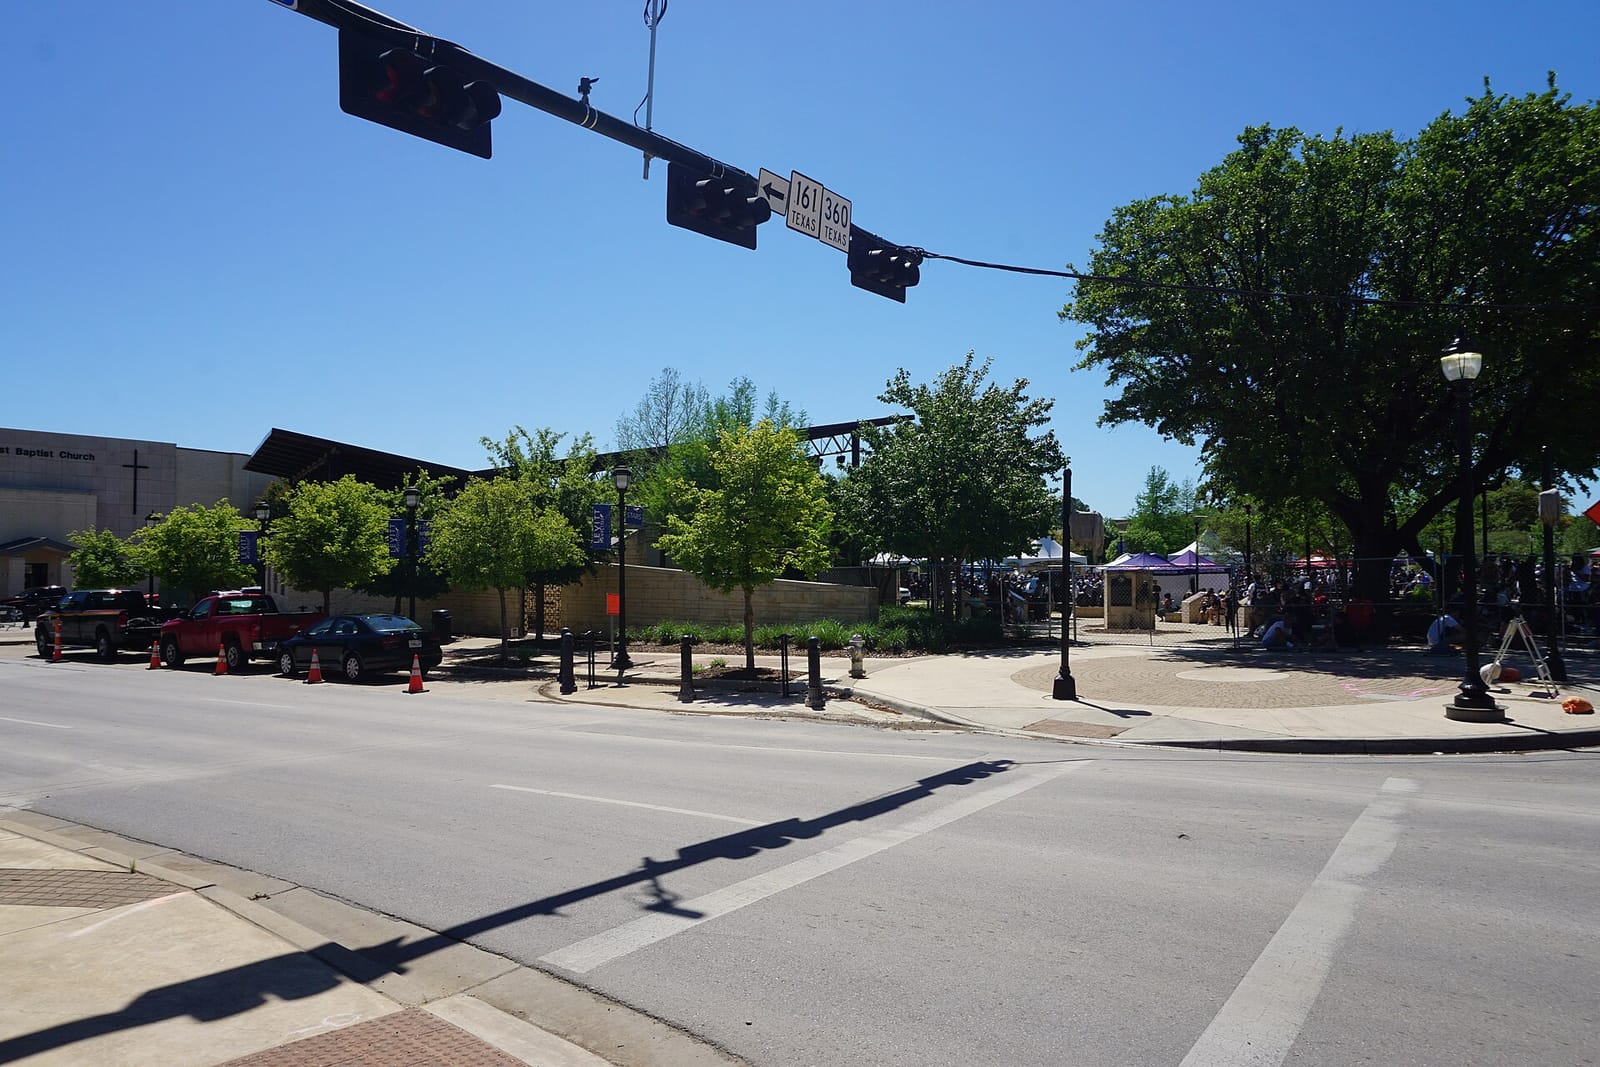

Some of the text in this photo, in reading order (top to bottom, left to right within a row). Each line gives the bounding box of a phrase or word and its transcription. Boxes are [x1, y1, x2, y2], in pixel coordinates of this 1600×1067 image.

[797, 181, 817, 213] 161
[791, 210, 816, 232] TEXAS
[825, 197, 848, 228] 360
[824, 225, 847, 246] TEXAS
[16, 447, 54, 458] Baptist
[59, 450, 95, 461] Church
